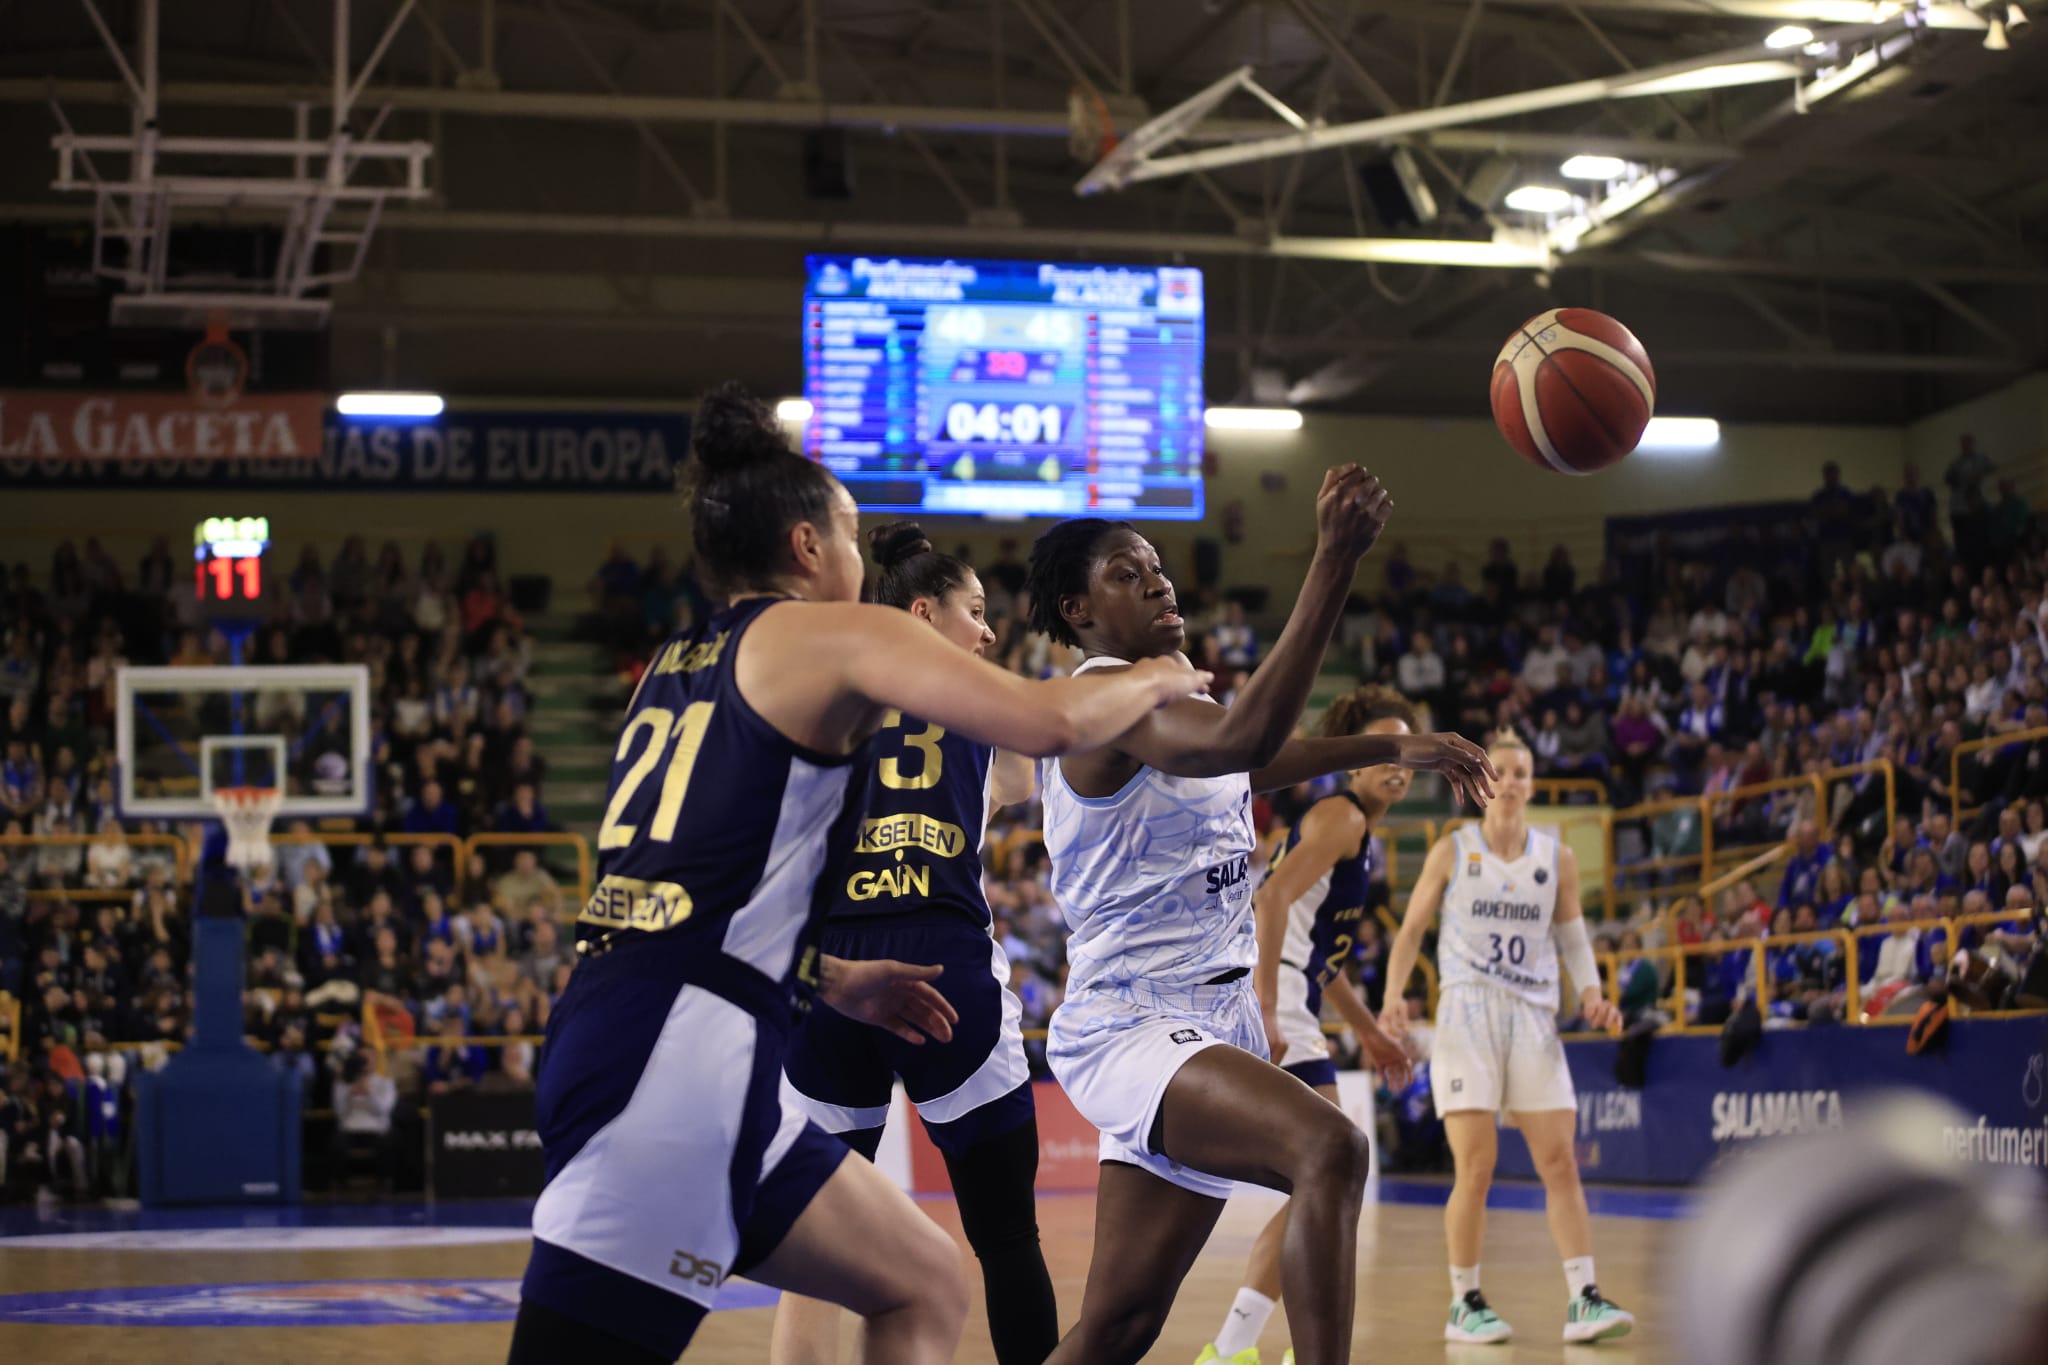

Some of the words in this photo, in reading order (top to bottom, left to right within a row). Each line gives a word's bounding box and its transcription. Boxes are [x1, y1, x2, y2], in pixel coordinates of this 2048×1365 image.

[948, 401, 1062, 443] 04:01
[410, 426, 476, 481] DE
[486, 426, 674, 482] EUROPA
[207, 555, 261, 600] 11
[877, 707, 946, 790] 3
[597, 700, 717, 850] 21
[854, 821, 956, 854] KSELEN
[1205, 855, 1248, 896] SALA
[1333, 903, 1365, 922] FEN
[1488, 932, 1526, 966] 30
[444, 1130, 508, 1150] MAX
[510, 1129, 543, 1150] FA
